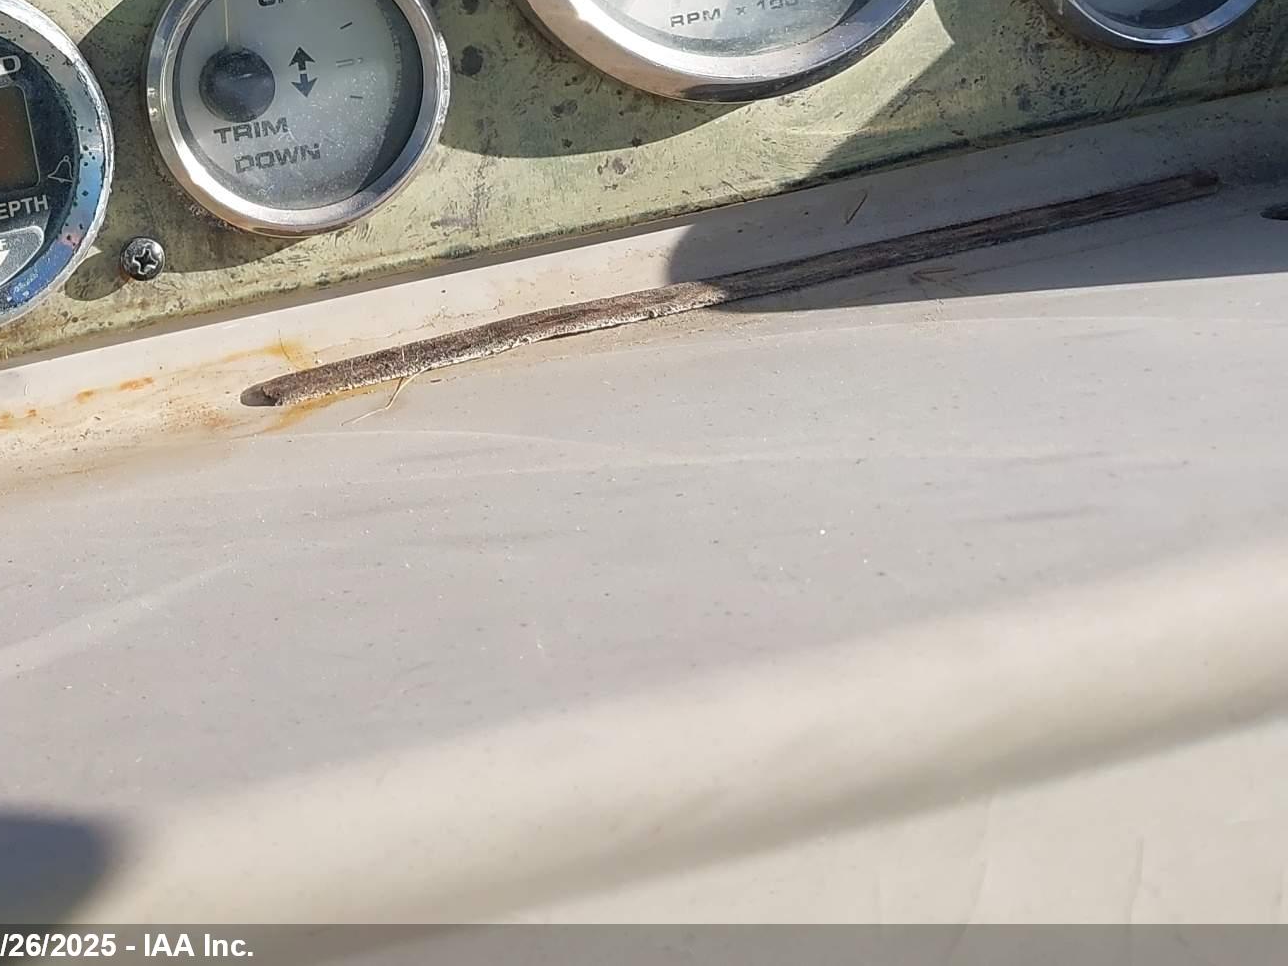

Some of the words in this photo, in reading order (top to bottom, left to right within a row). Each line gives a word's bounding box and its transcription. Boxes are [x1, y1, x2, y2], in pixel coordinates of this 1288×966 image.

[670, 7, 721, 28] RPM
[214, 117, 289, 144] TRIM
[234, 143, 321, 174] DOWN
